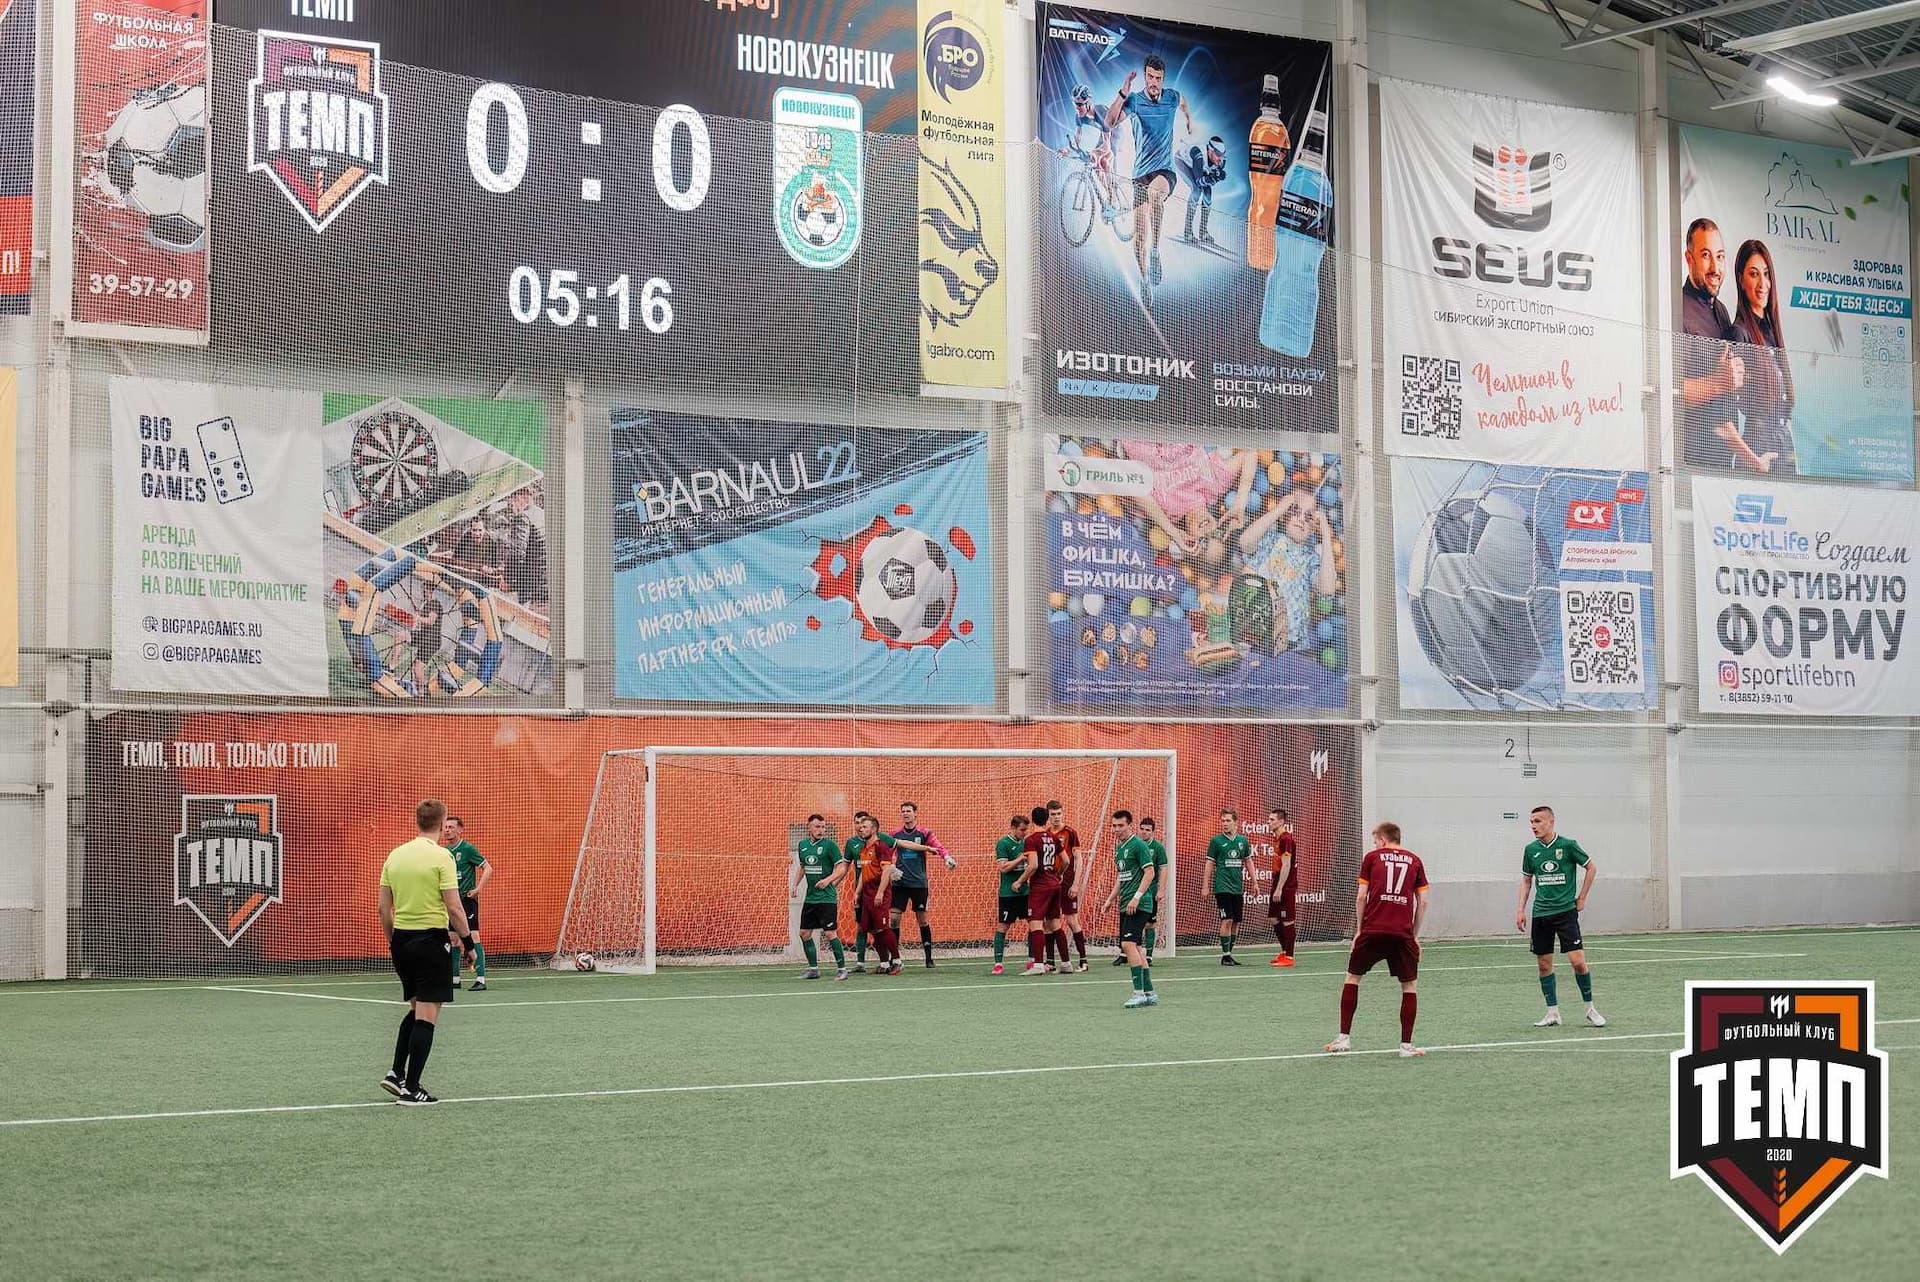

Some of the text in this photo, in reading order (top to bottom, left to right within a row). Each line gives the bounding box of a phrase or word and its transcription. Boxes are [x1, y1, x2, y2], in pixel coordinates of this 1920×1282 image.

[93, 12, 194, 34] ФУТБОЛЬНАЯ
[115, 34, 168, 49] ШКОЛА
[1049, 27, 1116, 46] BATTERADE
[738, 34, 895, 89] НОВОКУЗНЕЦК
[781, 98, 856, 120] НОВОКУЗНЕЦК
[922, 110, 994, 132] Молодёжная
[263, 90, 374, 162] ТЕМП
[923, 126, 994, 147] футбольная
[467, 82, 529, 193] 0
[652, 103, 712, 211] 0
[968, 150, 994, 162] лига
[1766, 212, 1840, 244] BAIKAL
[1431, 236, 1594, 291] SEUS
[1853, 259, 1903, 275] ЗДОРОВАЯ
[89, 273, 193, 299] 39-57-29
[1806, 270, 1904, 292] И КРАСИВАЯ УЛЫБКА
[509, 265, 674, 334] 05:16
[1476, 293, 1554, 316] Export Union
[1799, 290, 1904, 314] ЖДЕТ ТЕБЯ ЗДЕСЬ!
[1433, 310, 1594, 336] СИБИРСКИЙ ЭКСПОРТНЫЙ СОЮЗ
[1056, 350, 1197, 379] ИЗОТОНИК
[1213, 362, 1275, 377] ВОЗЬМИ
[1214, 378, 1313, 397] ВОССТАНОВИ
[1472, 359, 1575, 397] Чемпион в
[1215, 395, 1261, 409] СИЛЫ.
[1478, 382, 1624, 429] каждом из нас!
[139, 415, 172, 442] BIG
[141, 445, 190, 473] PAPA
[141, 473, 207, 503] GAMES
[1086, 470, 1123, 482] ГРИЛЬ
[1733, 494, 1787, 525] SL
[142, 524, 196, 548] АРЕНДА
[1062, 516, 1121, 540] В ЧЁМ
[1713, 526, 1809, 551] SportLife
[142, 550, 242, 574] РАЗВЛЕЧЕНИЙ
[1063, 546, 1146, 569] ФИШКА,
[1815, 531, 1911, 571] Создаем
[142, 575, 308, 602] НА ВАШЕ МЕРОПРИЯТИЕ
[637, 559, 747, 604] ГЕНЕРАЛЬНЫЙ
[1064, 569, 1176, 592] БРАТИШКА?
[1715, 566, 1906, 603] СПОРТИВНУЮ
[638, 585, 788, 642] ИНФОРМАЦИОННЫЙ
[162, 618, 263, 637] BIGPAPAGAMES.RU
[1716, 603, 1906, 662] ФОРМУ
[162, 645, 263, 665] @BIGPAPAGAMES
[638, 621, 798, 675] ПАРТНЕР ФК «ТЕМП»
[1742, 664, 1856, 689] sportlifebrn
[121, 741, 338, 770] ТЕМП, ТЕМП, ТОЛЬКО ТЕМП!
[1505, 738, 1515, 758] 2
[187, 838, 273, 888] ТЕМП
[1043, 844, 1055, 865] 22
[1385, 861, 1408, 894] 17
[1380, 895, 1408, 904] SEUS
